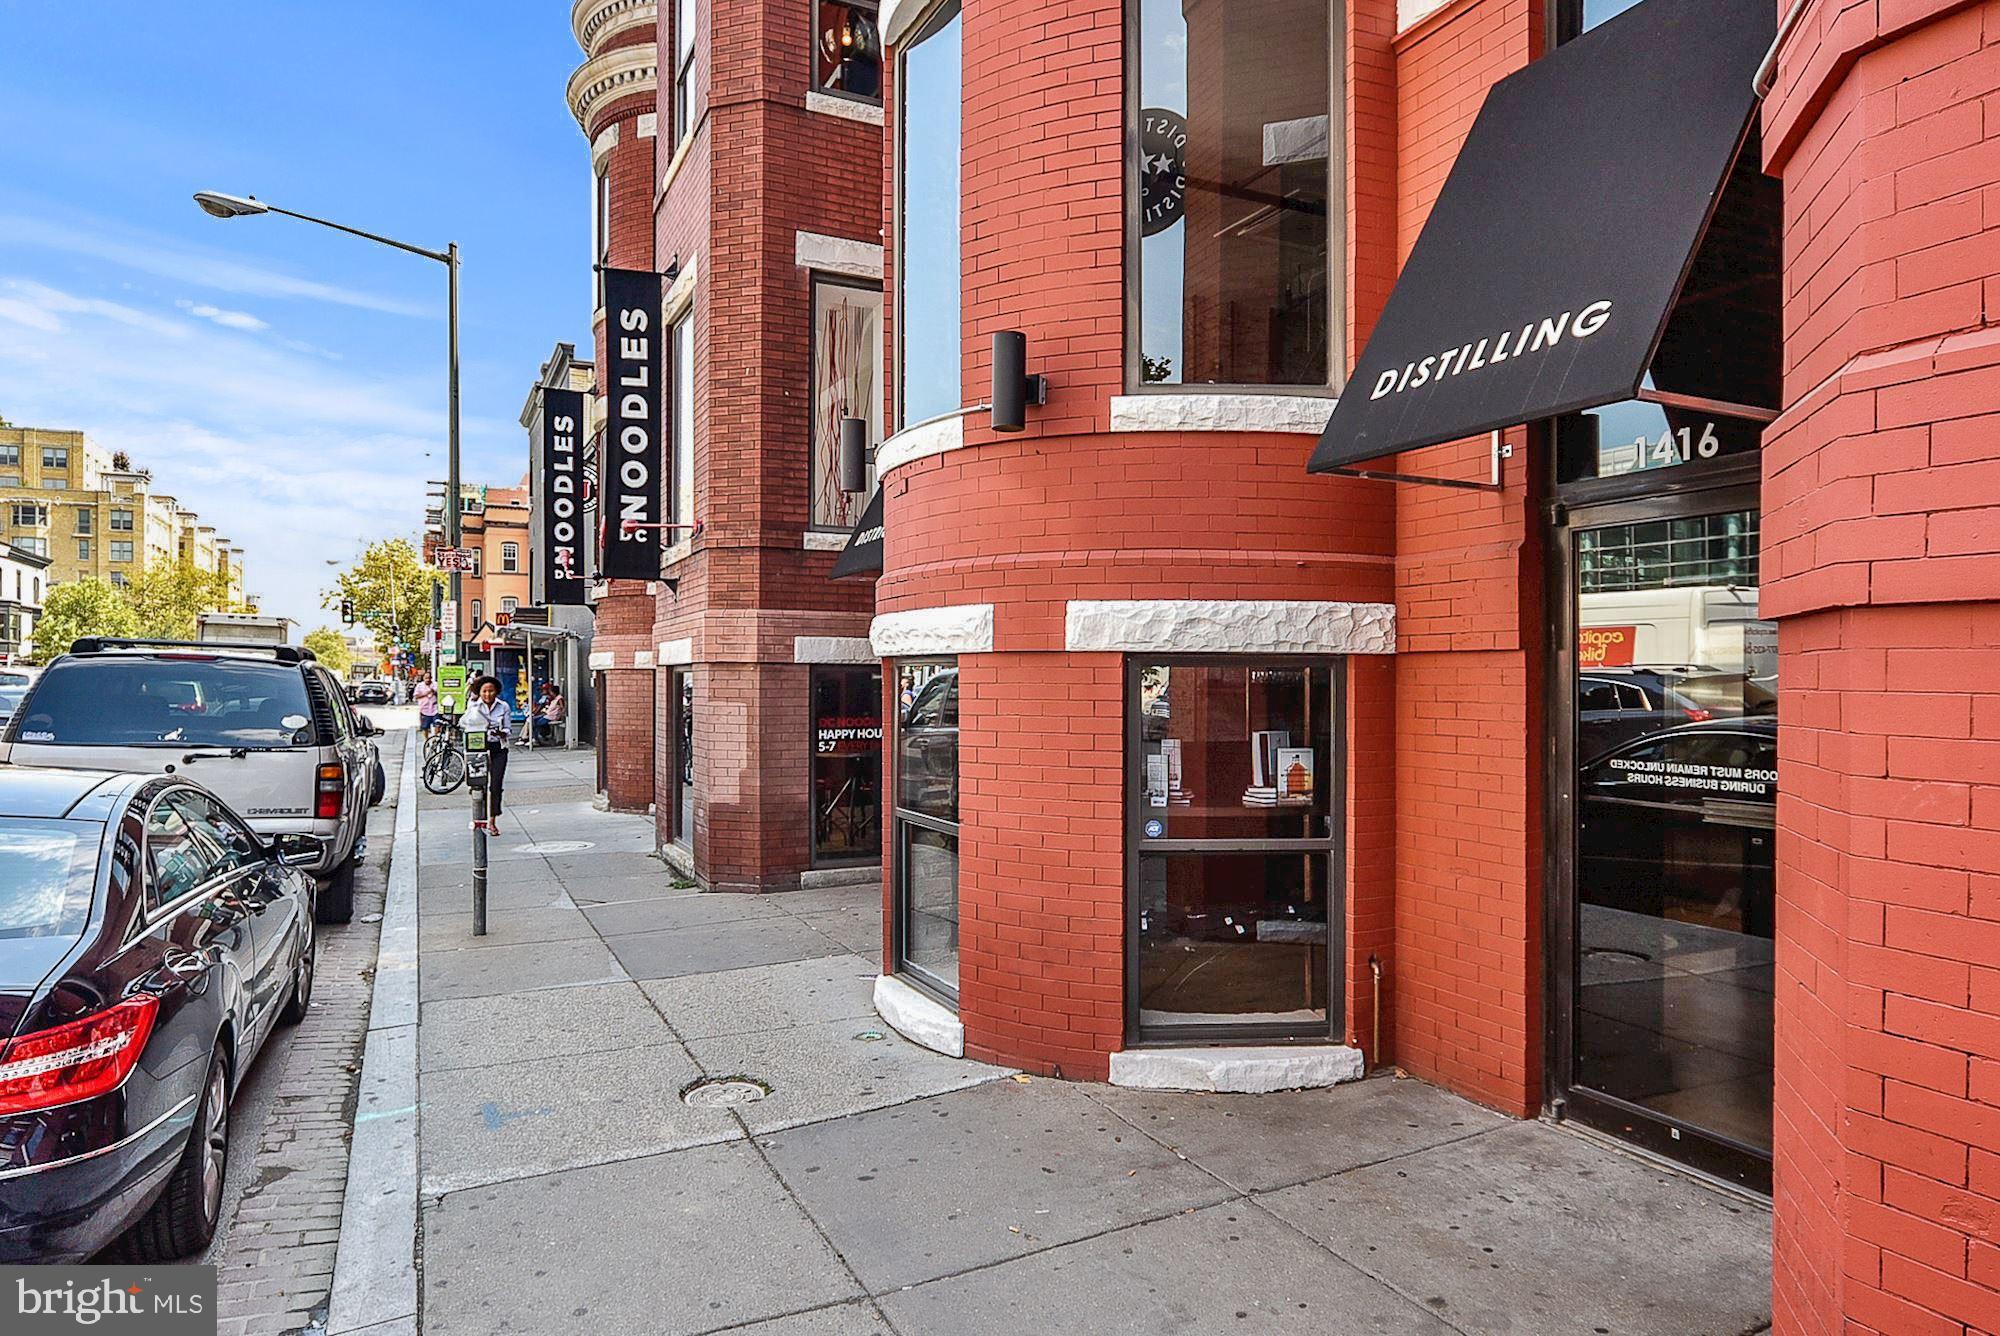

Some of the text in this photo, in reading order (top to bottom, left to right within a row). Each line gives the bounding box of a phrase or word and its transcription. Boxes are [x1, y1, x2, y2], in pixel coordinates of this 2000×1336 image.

[1369, 300, 1613, 401] DISTILLING
[619, 307, 649, 522] NOODLES
[1634, 422, 1719, 470] 1416
[818, 728, 883, 740] HAPPY HOU
[818, 741, 837, 752] 5-7
[247, 807, 310, 815] CHEVROLET
